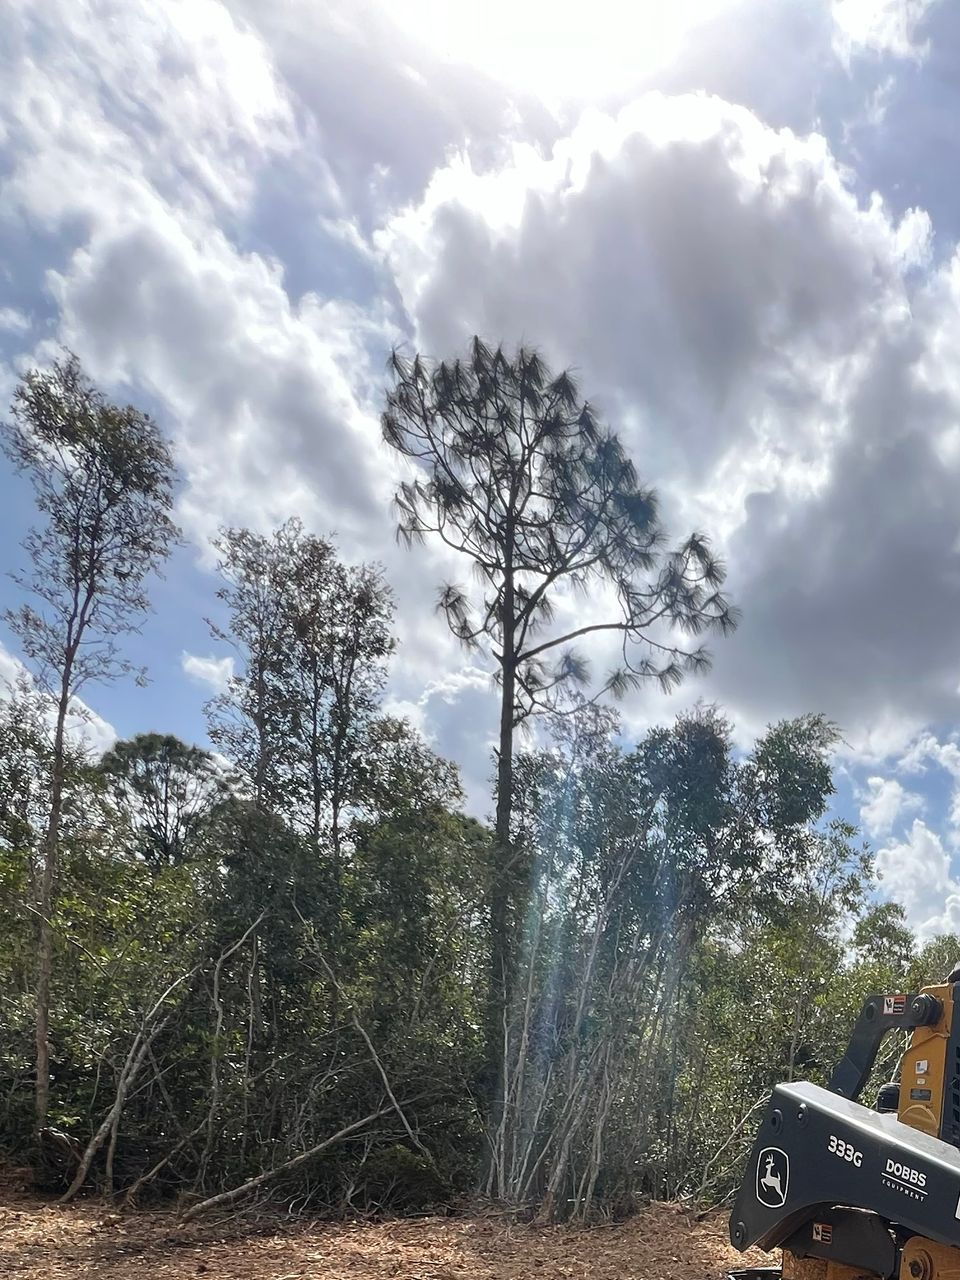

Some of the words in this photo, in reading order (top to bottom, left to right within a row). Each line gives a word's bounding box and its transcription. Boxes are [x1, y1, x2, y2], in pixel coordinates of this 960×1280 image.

[828, 1135, 864, 1168] 333G
[886, 1159, 927, 1187] DOBBS
[882, 1179, 925, 1203] EQUIPMENT
